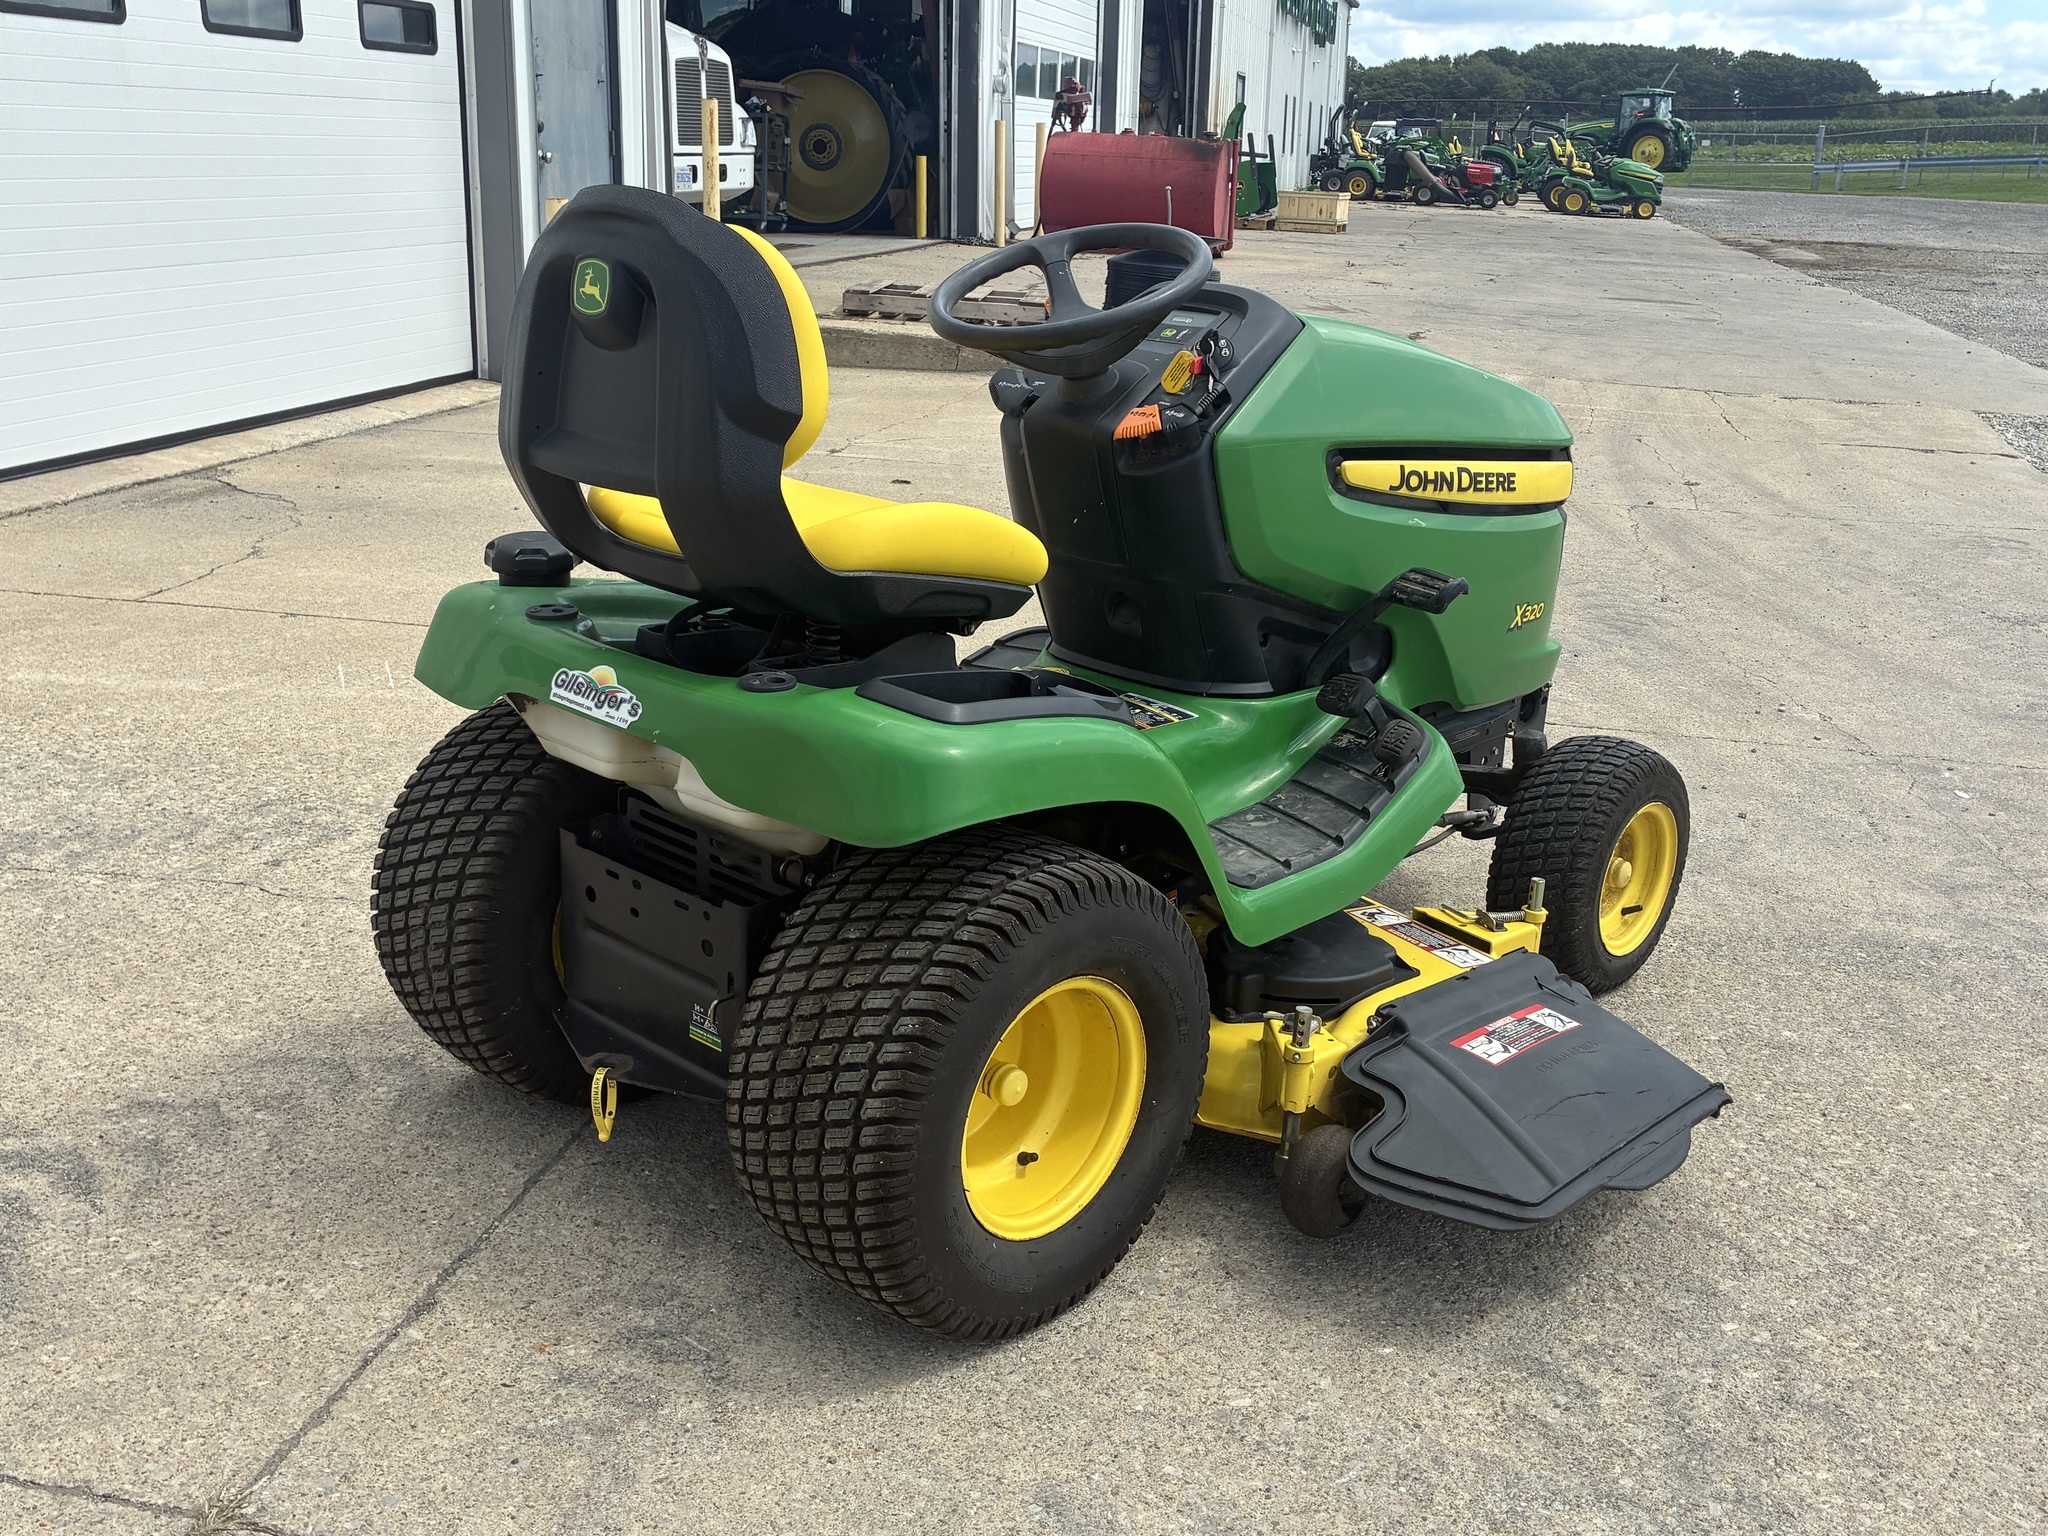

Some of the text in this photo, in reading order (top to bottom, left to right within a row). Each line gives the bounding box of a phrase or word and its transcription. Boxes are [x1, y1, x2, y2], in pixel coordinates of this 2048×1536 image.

[1389, 464, 1517, 493] JOHN DEERE
[1507, 601, 1545, 633] X320
